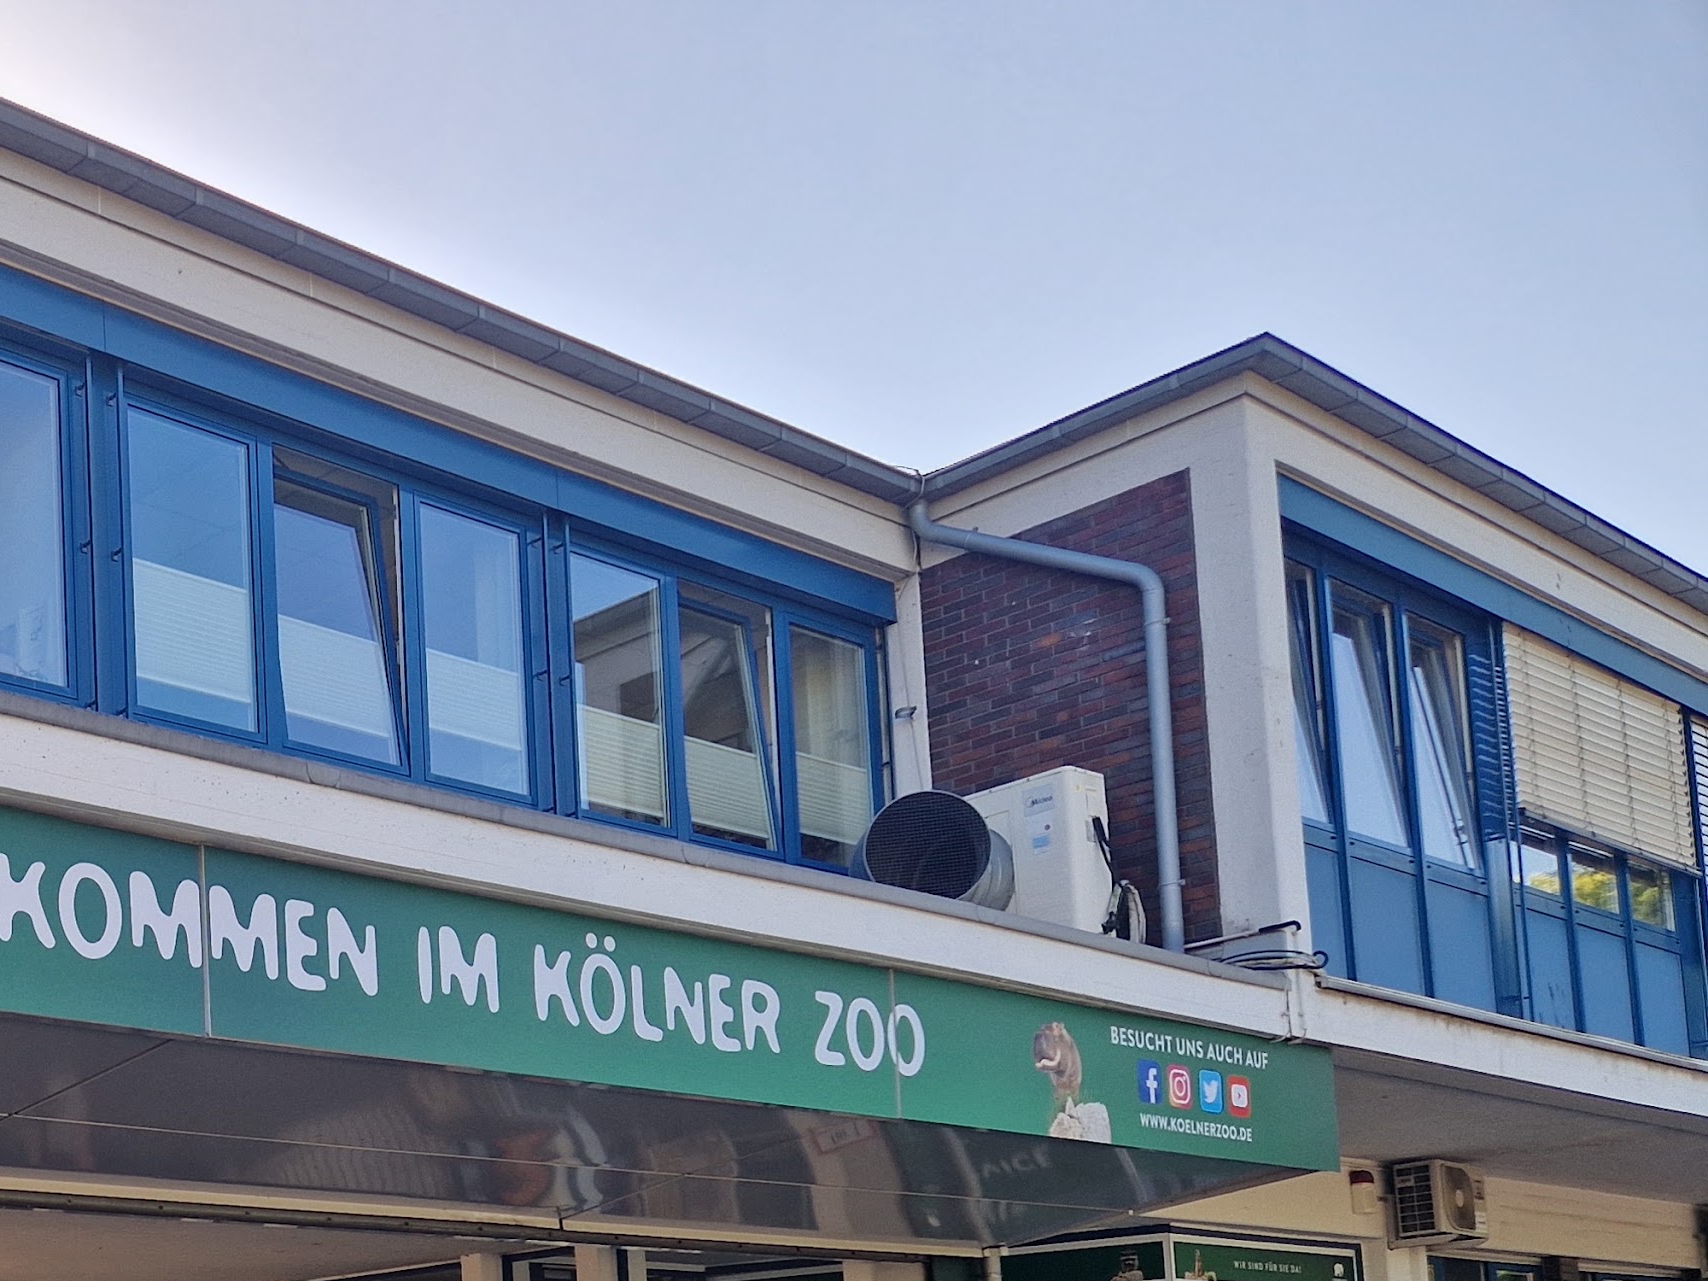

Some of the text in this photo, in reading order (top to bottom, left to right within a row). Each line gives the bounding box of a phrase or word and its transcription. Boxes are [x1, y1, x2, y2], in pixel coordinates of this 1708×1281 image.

[417, 925, 500, 1014] IM
[533, 932, 781, 1054] KÖLNER
[813, 990, 926, 1077] ZOO
[1109, 1025, 1269, 1070] BESUCHT UNS AUCH AUF
[1139, 1112, 1253, 1143] WWW.KOELNERZOO.DE
